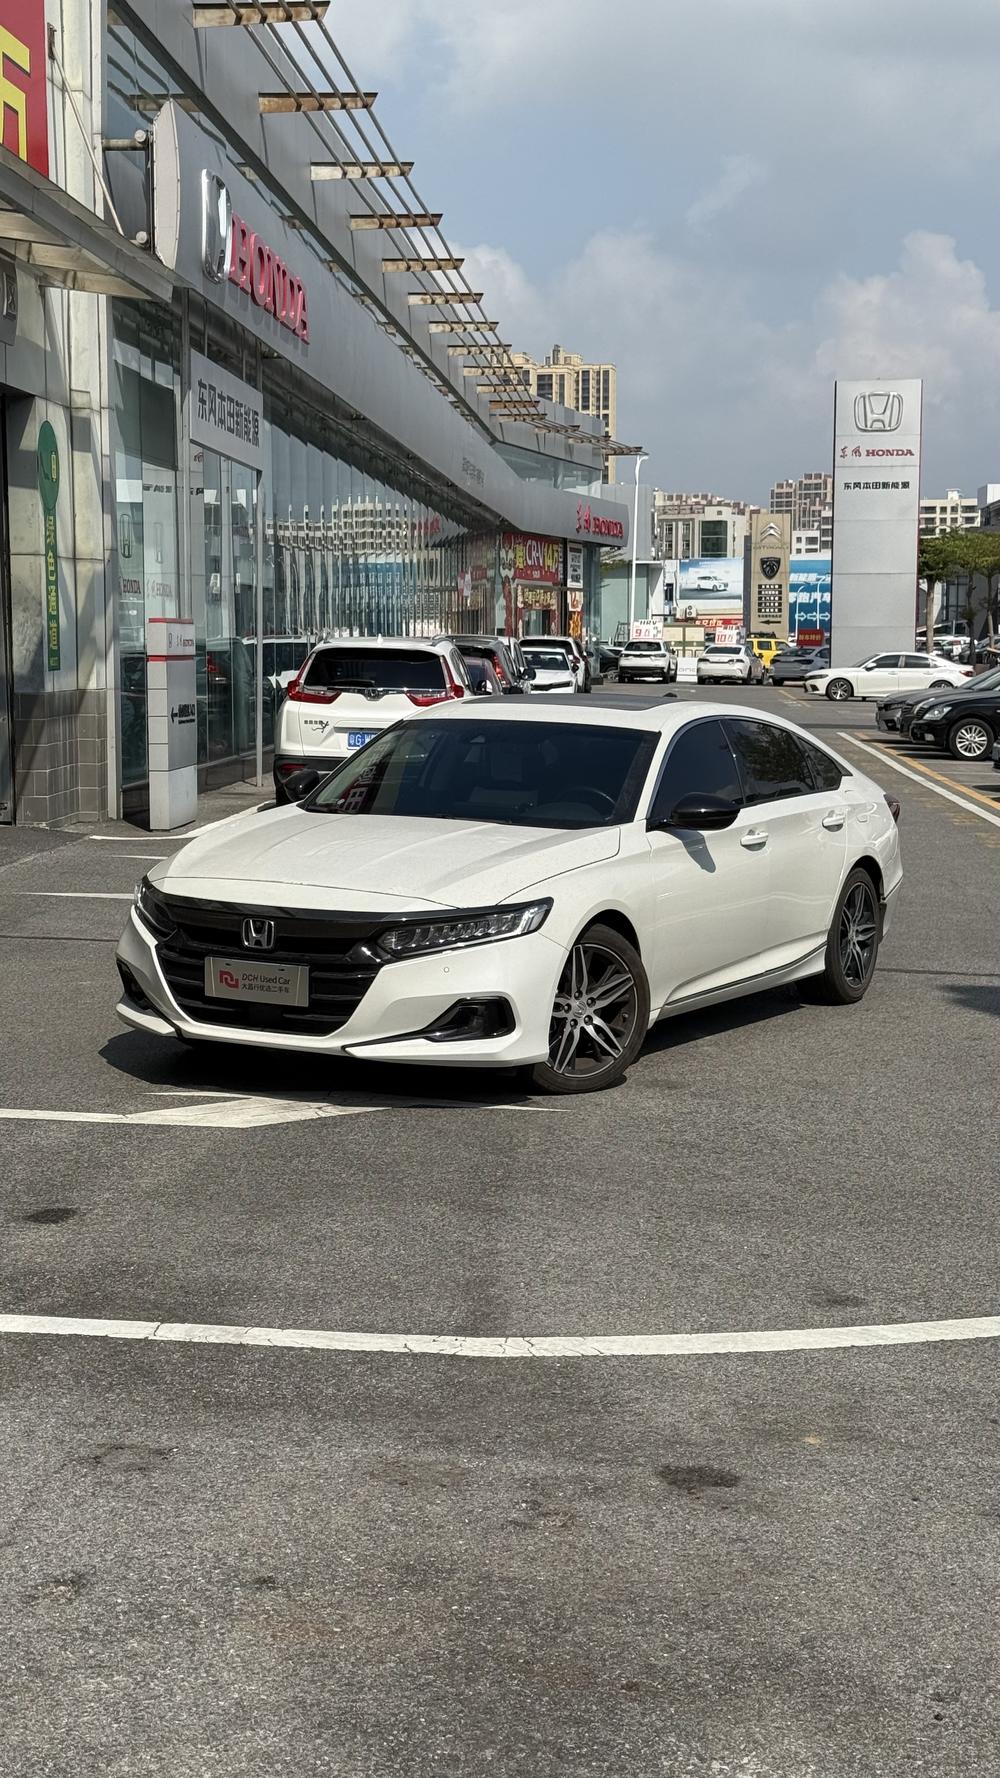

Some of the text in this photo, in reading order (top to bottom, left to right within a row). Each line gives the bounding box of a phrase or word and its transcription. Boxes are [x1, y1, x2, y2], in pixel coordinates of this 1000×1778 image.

[228, 212, 309, 344] HONDA
[198, 378, 260, 448] 东风本田新能源
[865, 449, 915, 457] HONDA
[844, 481, 911, 490] 东风本田新能源
[592, 516, 624, 539] HONDA
[526, 539, 545, 566] CR-V
[241, 973, 291, 985] DCH Used Car
